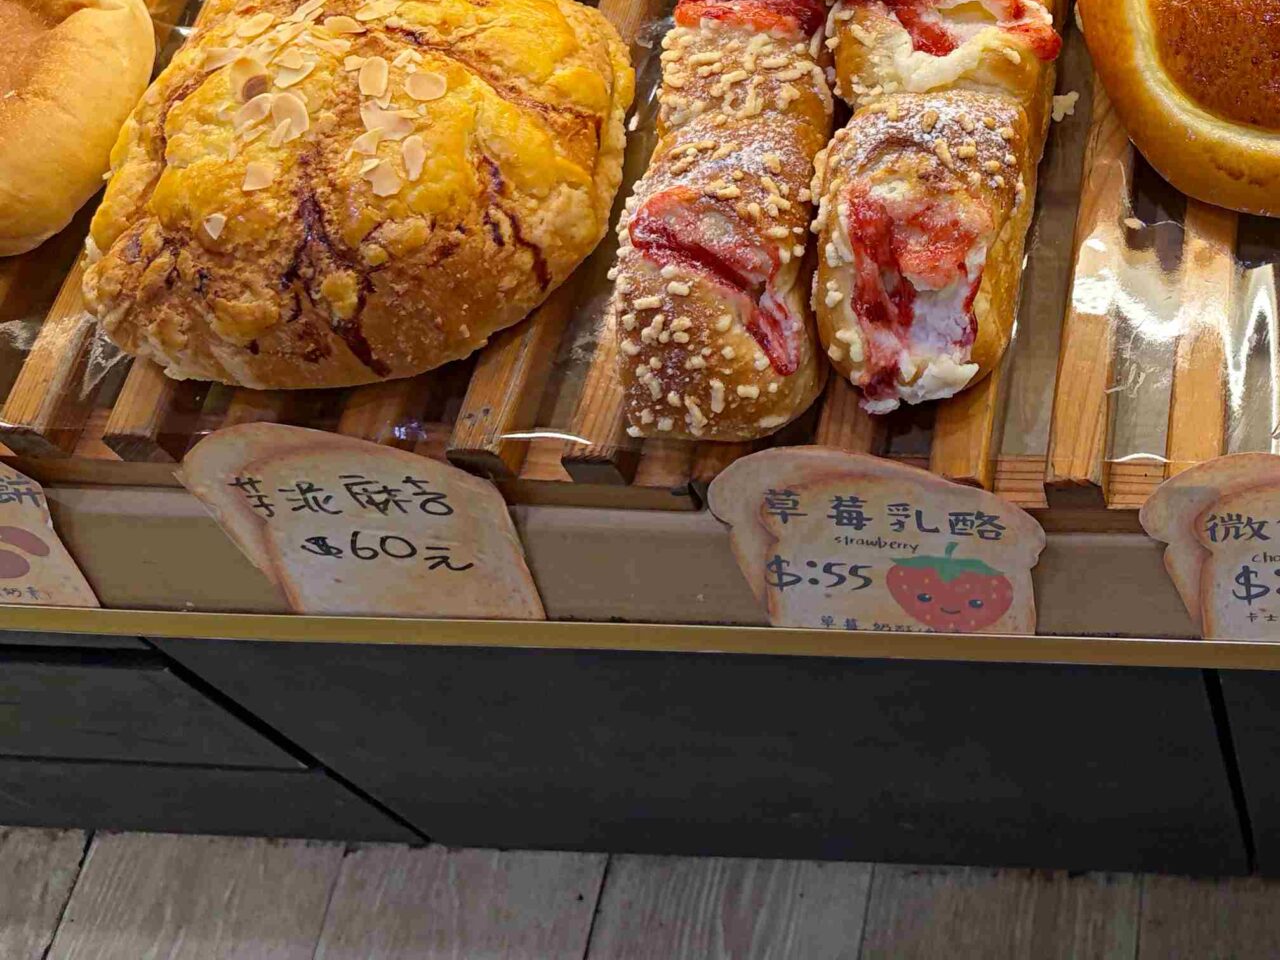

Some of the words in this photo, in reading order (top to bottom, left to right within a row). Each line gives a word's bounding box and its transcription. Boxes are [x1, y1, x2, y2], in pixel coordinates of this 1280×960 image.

[764, 489, 1007, 541] 草莓乳酪
[834, 535, 919, 554] strawberry
